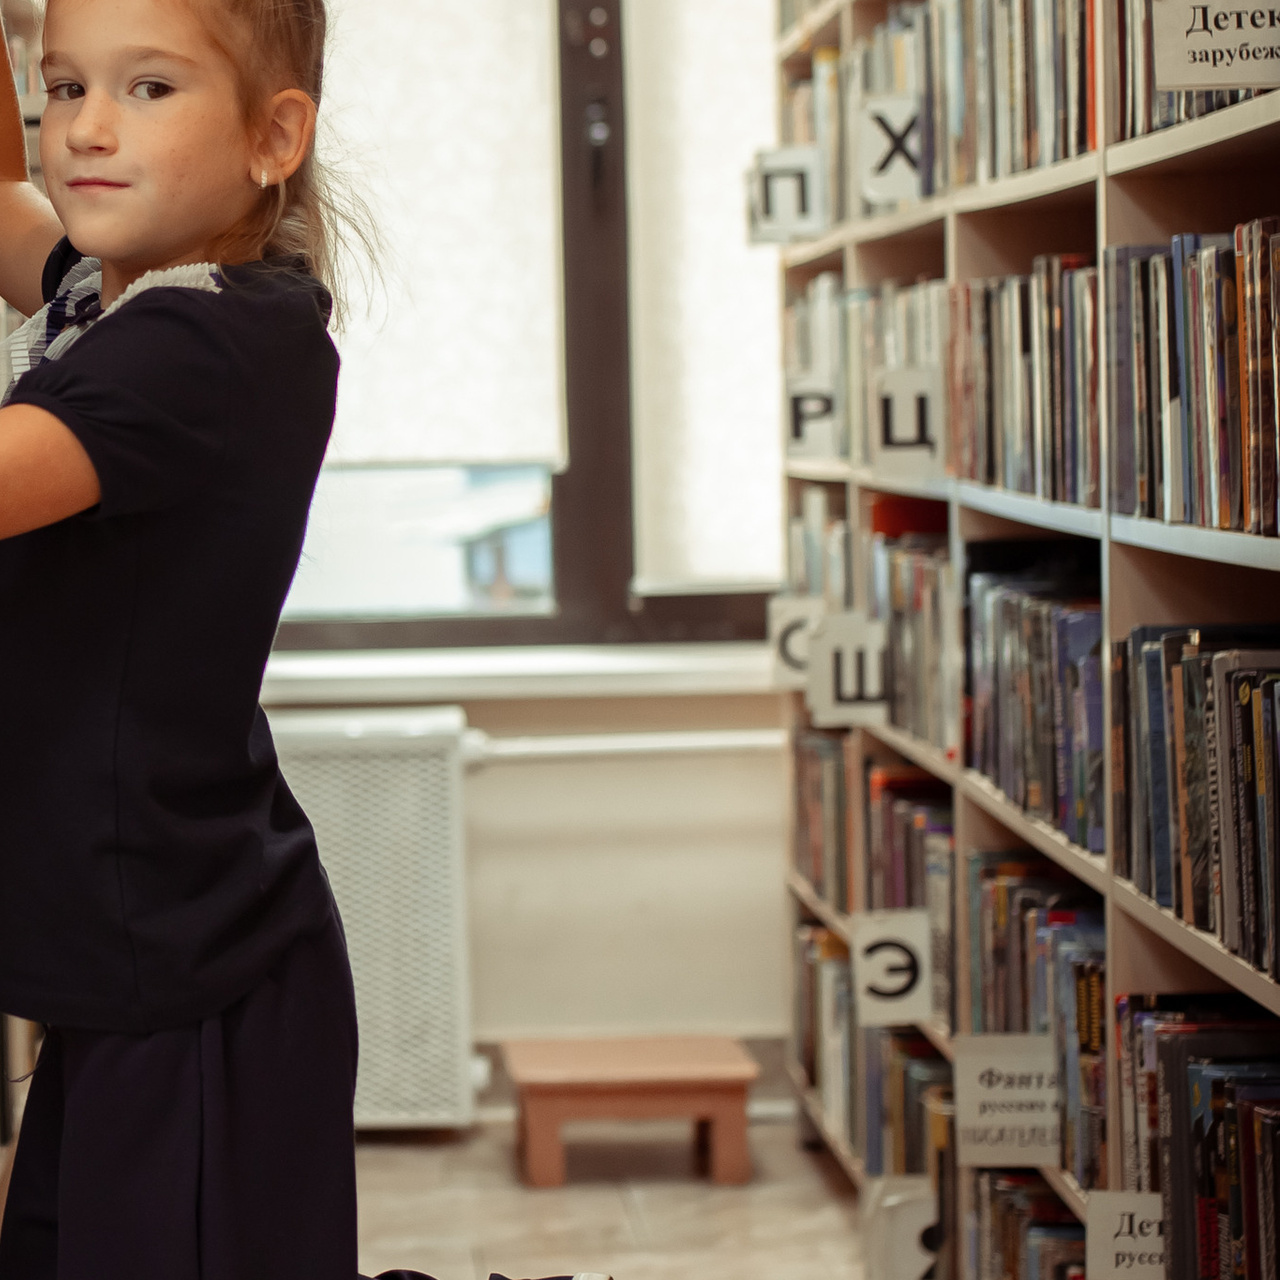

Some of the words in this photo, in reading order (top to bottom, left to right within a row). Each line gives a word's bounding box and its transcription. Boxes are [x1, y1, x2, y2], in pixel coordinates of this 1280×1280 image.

[873, 114, 919, 175] Х
[762, 171, 808, 216] П
[790, 394, 833, 440] Р
[881, 394, 936, 458] Ц
[864, 940, 919, 998] Э
